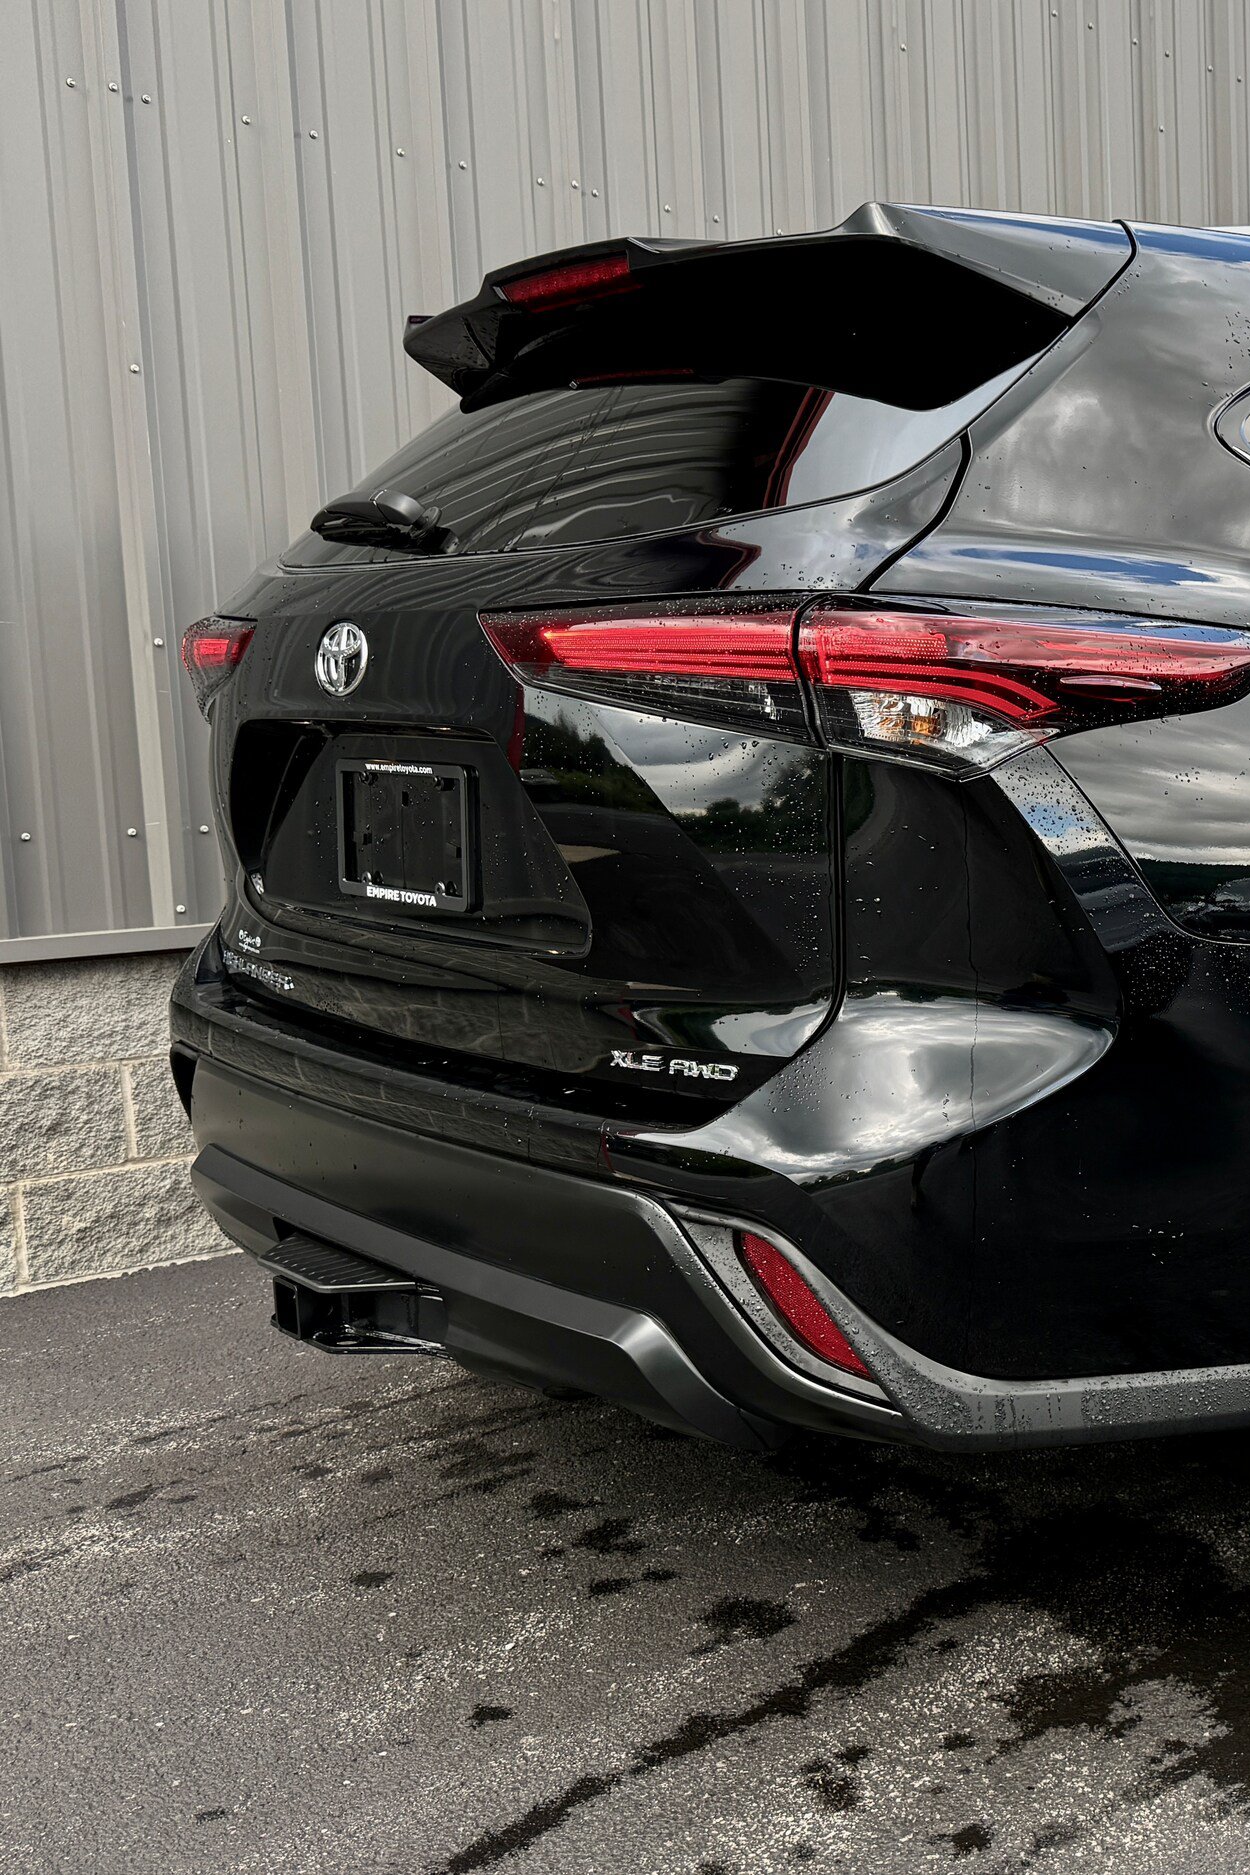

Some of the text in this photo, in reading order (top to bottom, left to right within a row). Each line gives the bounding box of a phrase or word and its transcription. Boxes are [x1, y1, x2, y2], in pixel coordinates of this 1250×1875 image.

[365, 763, 433, 775] www.empiretoyota.com
[366, 885, 437, 907] EMPIRE TOYOTA
[610, 1050, 739, 1082] XLE AWD
